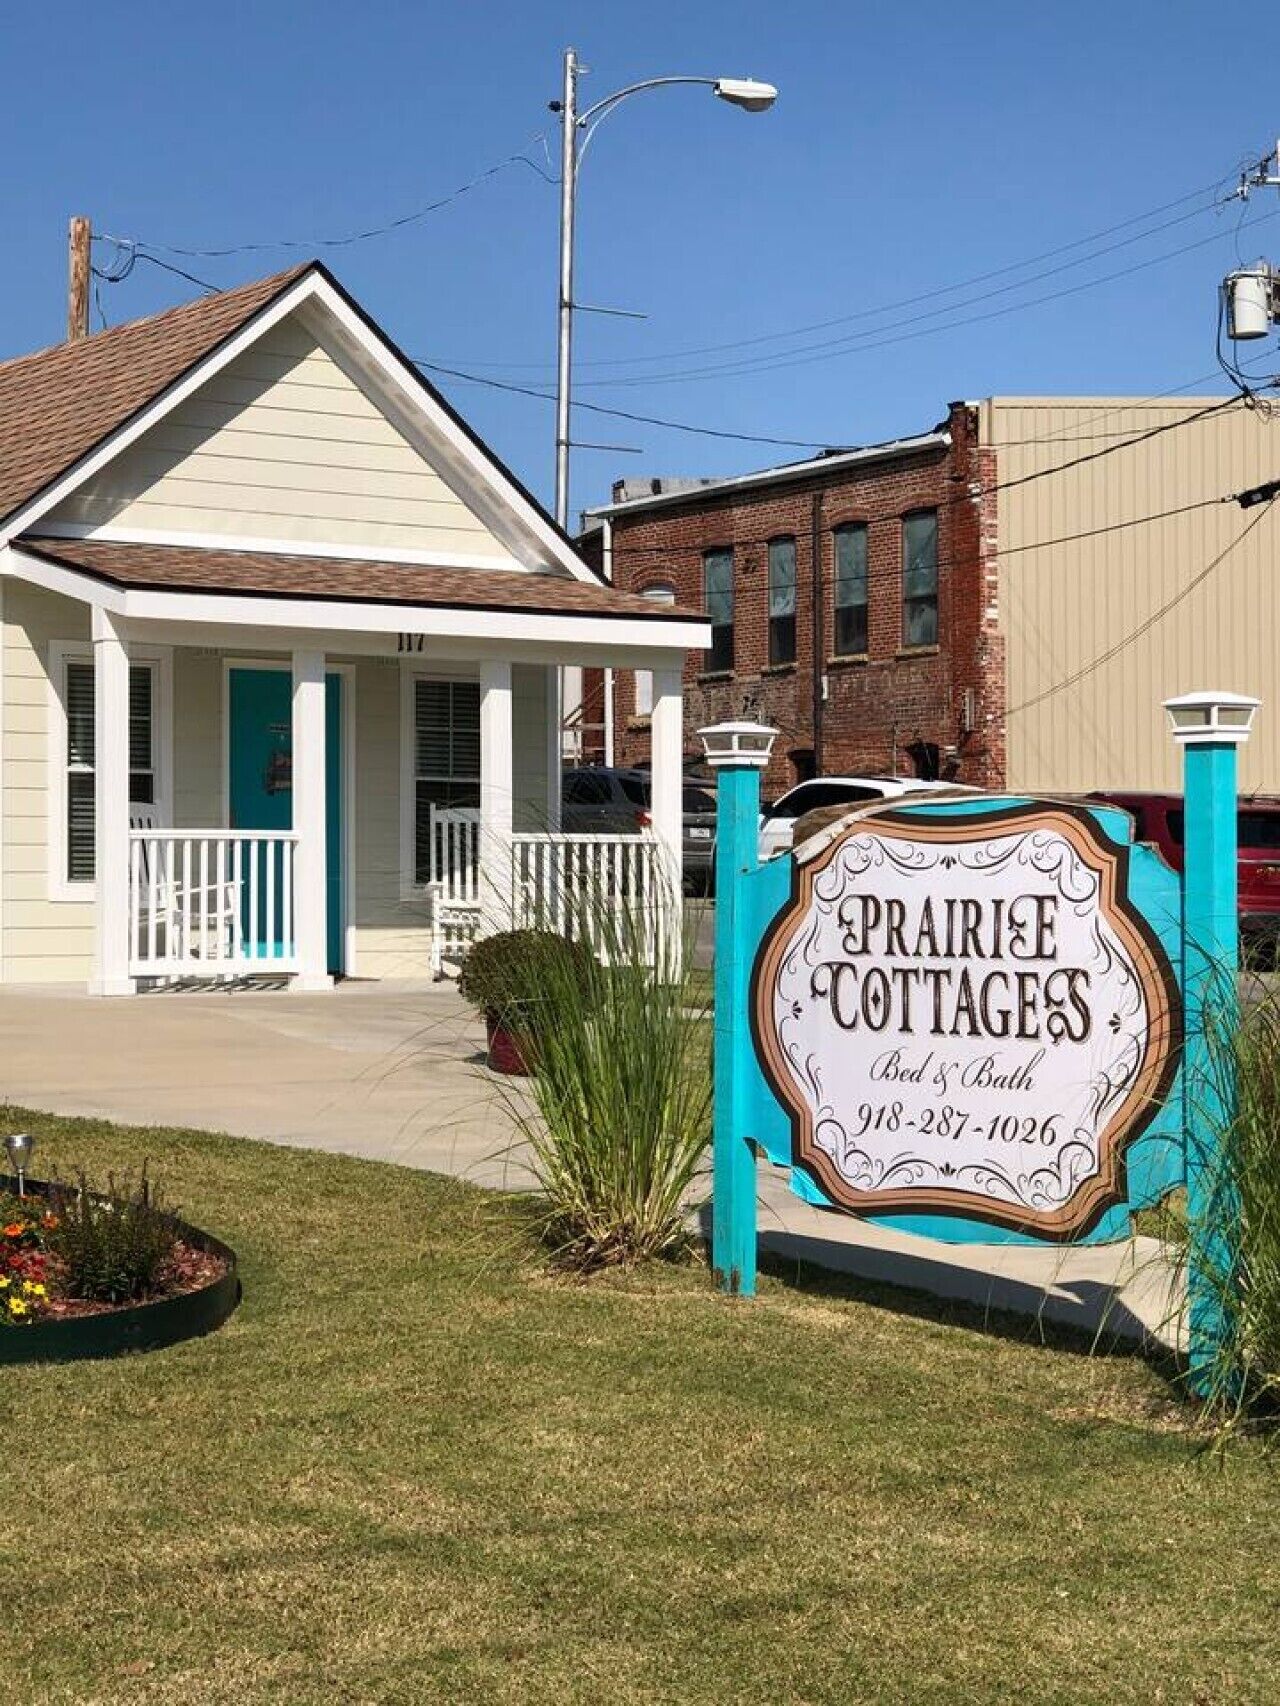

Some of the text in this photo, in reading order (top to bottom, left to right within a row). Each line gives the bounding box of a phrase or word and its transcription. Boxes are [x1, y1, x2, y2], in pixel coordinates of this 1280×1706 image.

[397, 632, 424, 652] 117
[838, 894, 1059, 959] PRAIRIE
[810, 961, 1092, 1044] COTTAGES
[869, 1047, 1046, 1096] Bed & Bath
[857, 1101, 1065, 1147] 918-287-1026
